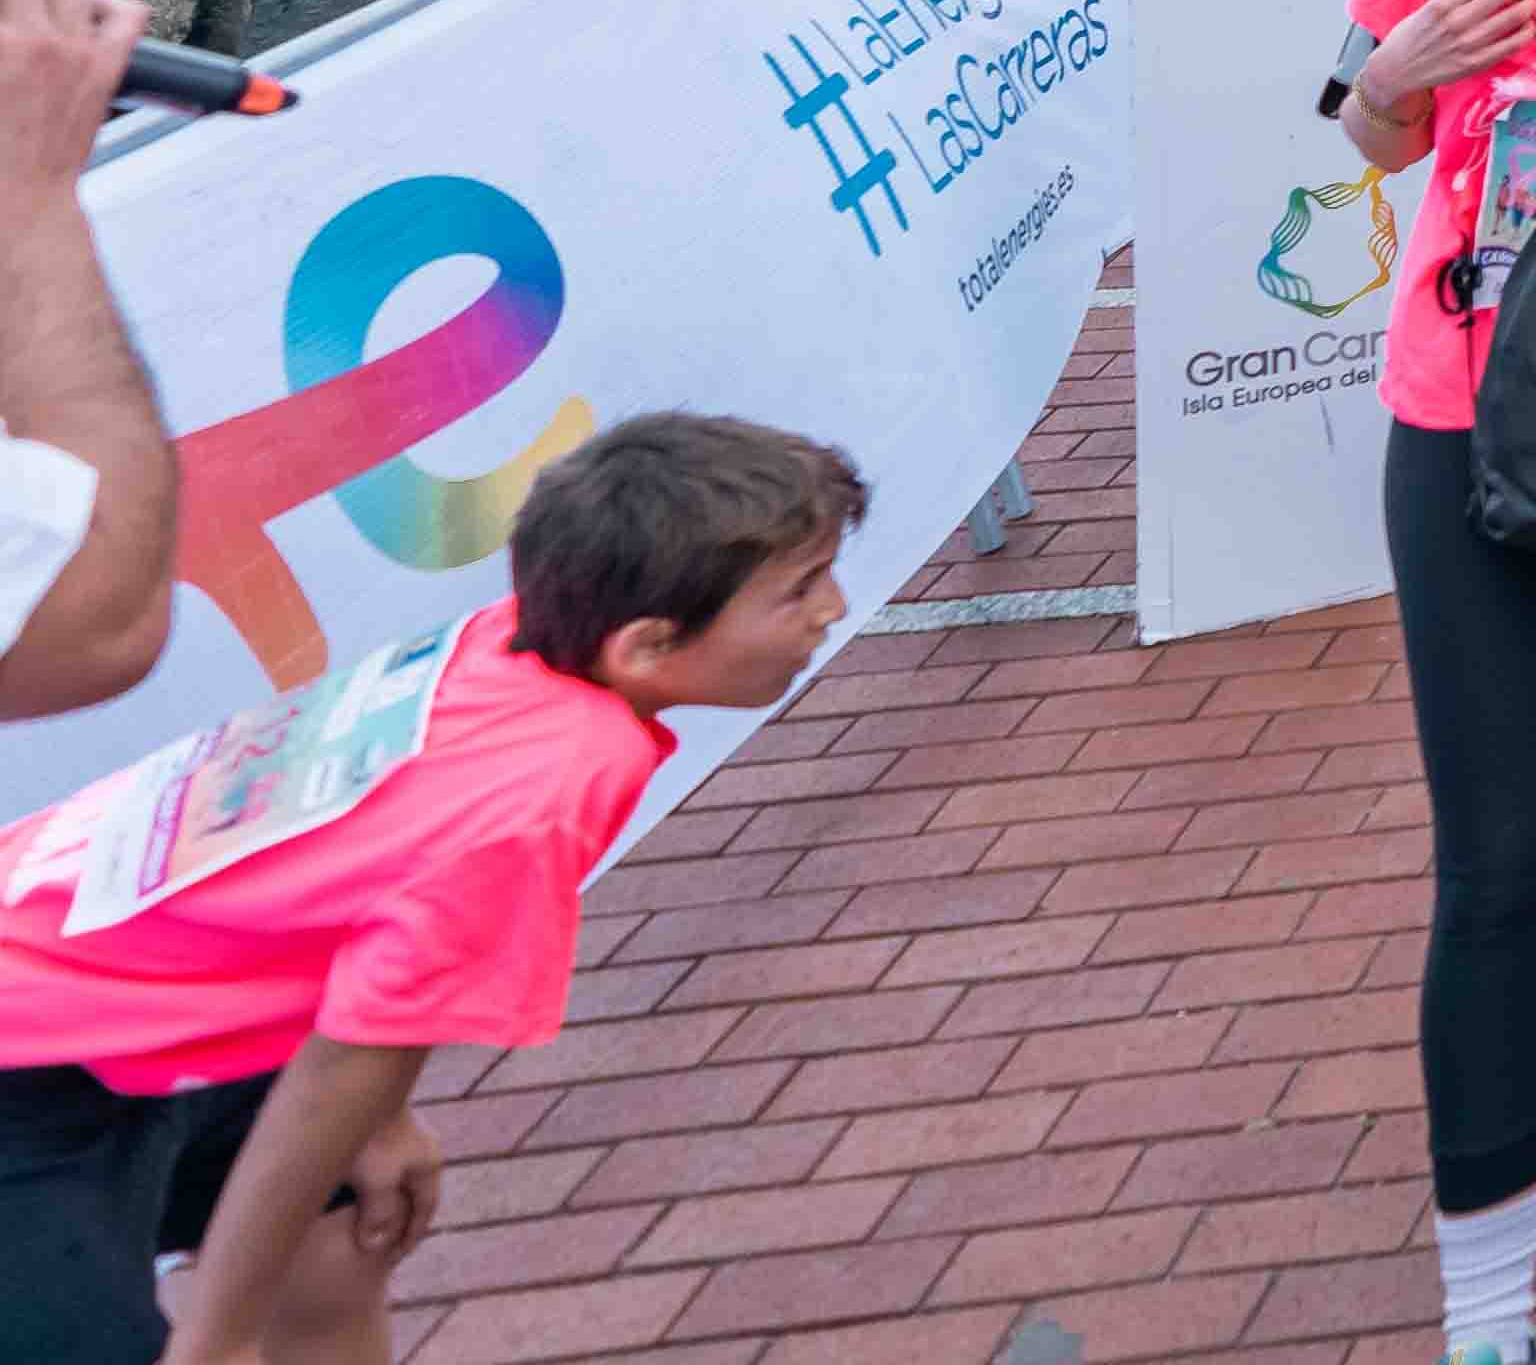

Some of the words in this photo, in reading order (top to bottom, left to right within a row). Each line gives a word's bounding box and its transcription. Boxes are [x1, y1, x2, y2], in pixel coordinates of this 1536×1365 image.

[957, 164, 1076, 313] totalenergies.es
[1182, 393, 1224, 417] Isla
[1231, 373, 1333, 408] Europea
[1339, 364, 1378, 387] del
[1185, 345, 1298, 387] Gran
